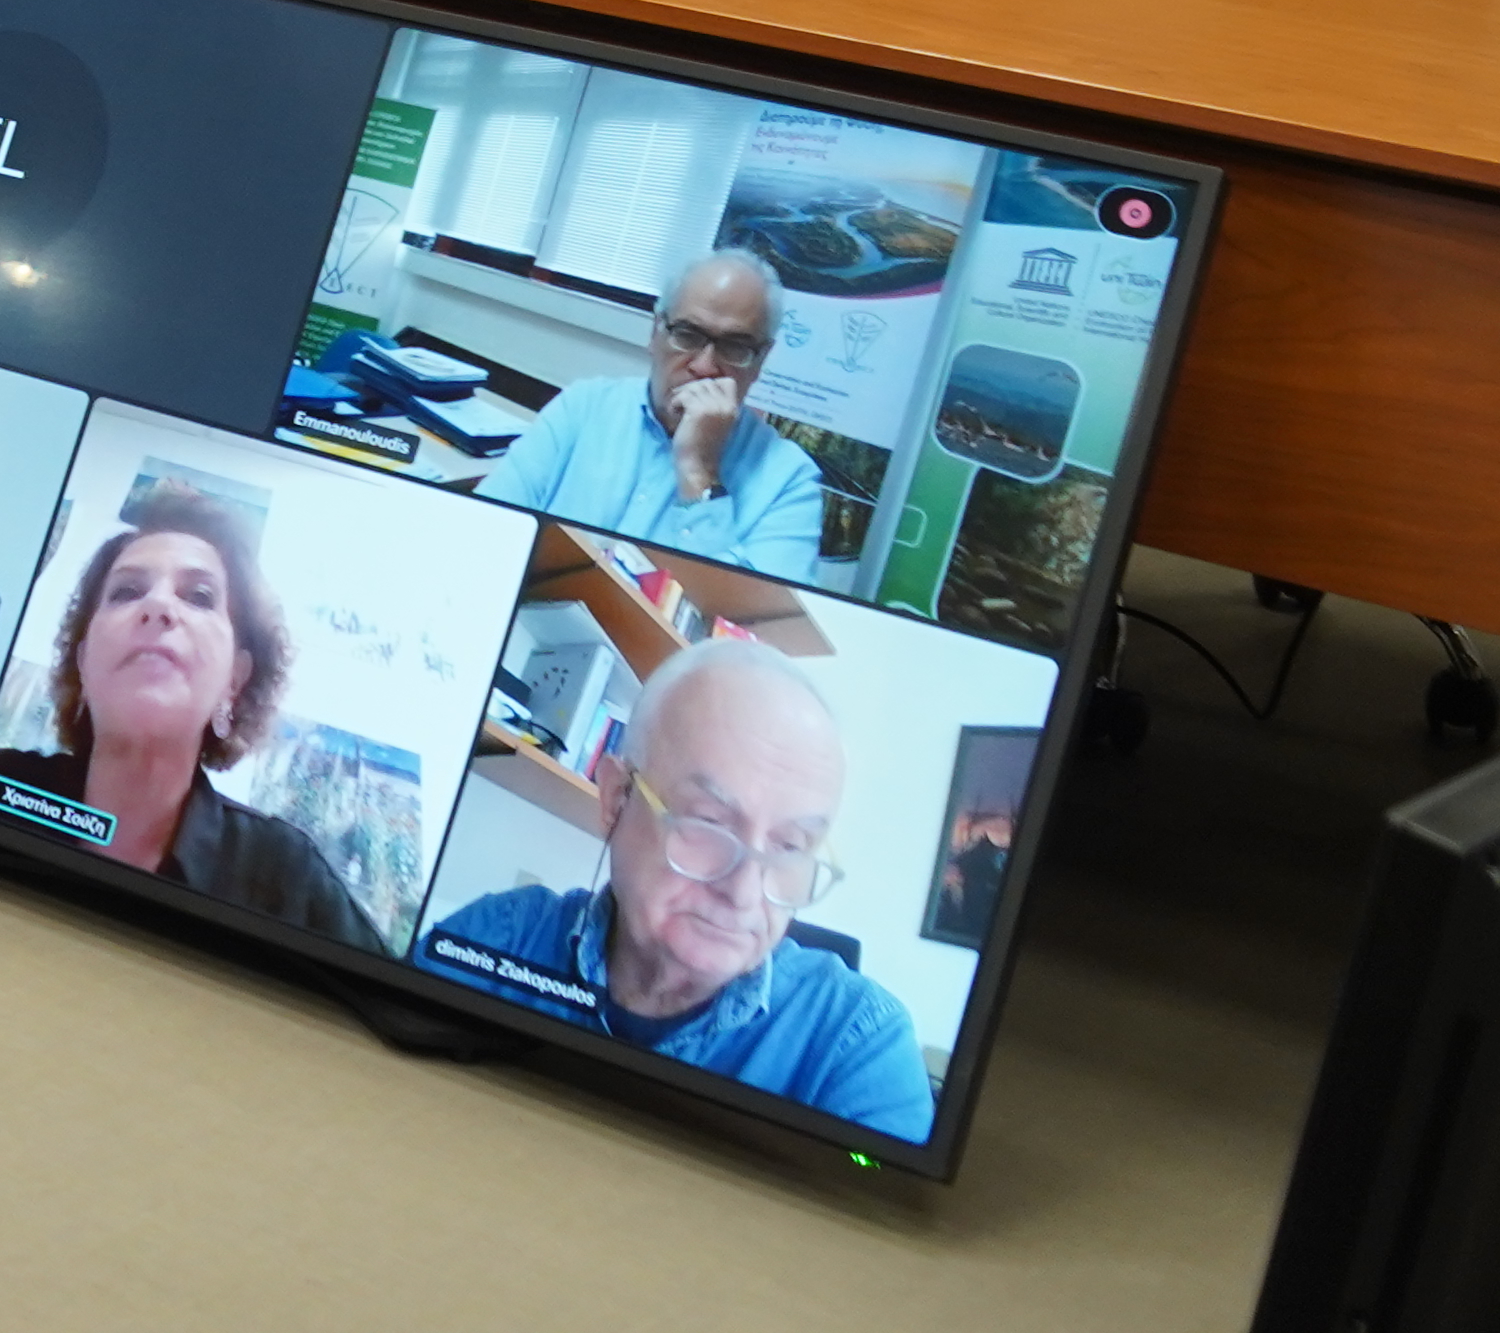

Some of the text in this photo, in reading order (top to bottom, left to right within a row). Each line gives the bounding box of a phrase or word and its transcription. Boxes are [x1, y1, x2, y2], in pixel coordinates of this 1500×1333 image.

[293, 410, 411, 455] Emmanouloudis
[1, 785, 106, 839] Χριστίνα Σούζη
[435, 938, 597, 1009] dimitris Ziakopoulos
